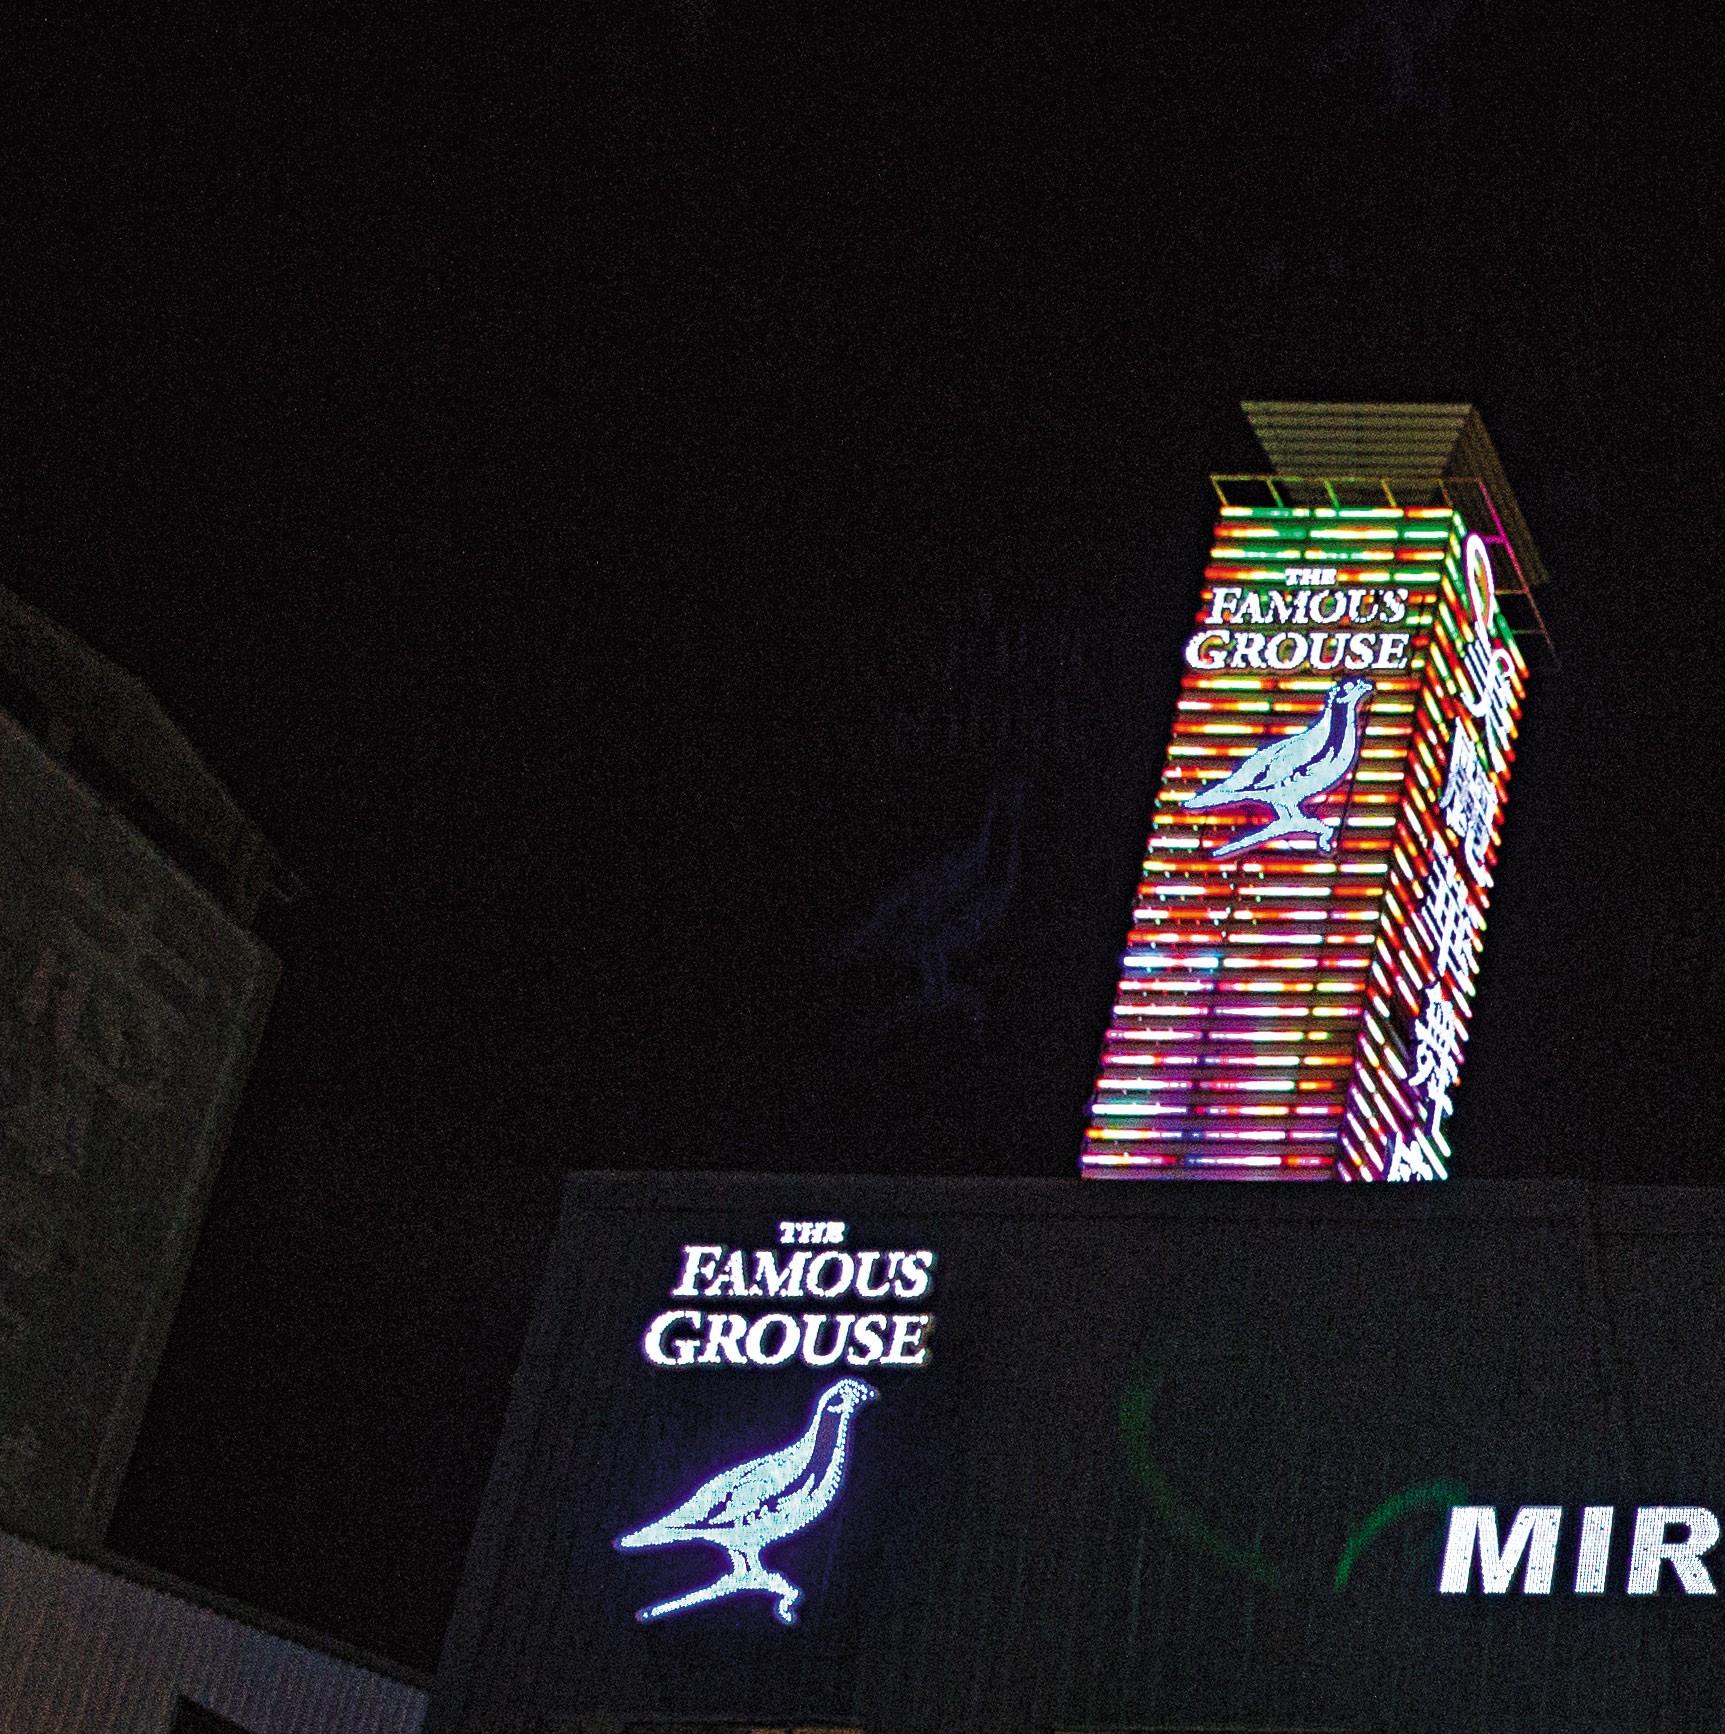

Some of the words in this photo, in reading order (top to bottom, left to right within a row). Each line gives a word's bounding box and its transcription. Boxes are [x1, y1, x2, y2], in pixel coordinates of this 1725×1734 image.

[1284, 568, 1337, 586] THE
[1204, 587, 1409, 624] FAMOUS
[1184, 629, 1410, 670] GROUSE
[779, 1221, 846, 1244] THE
[671, 1245, 933, 1299] FAMOUS
[643, 1310, 931, 1367] GROUSE
